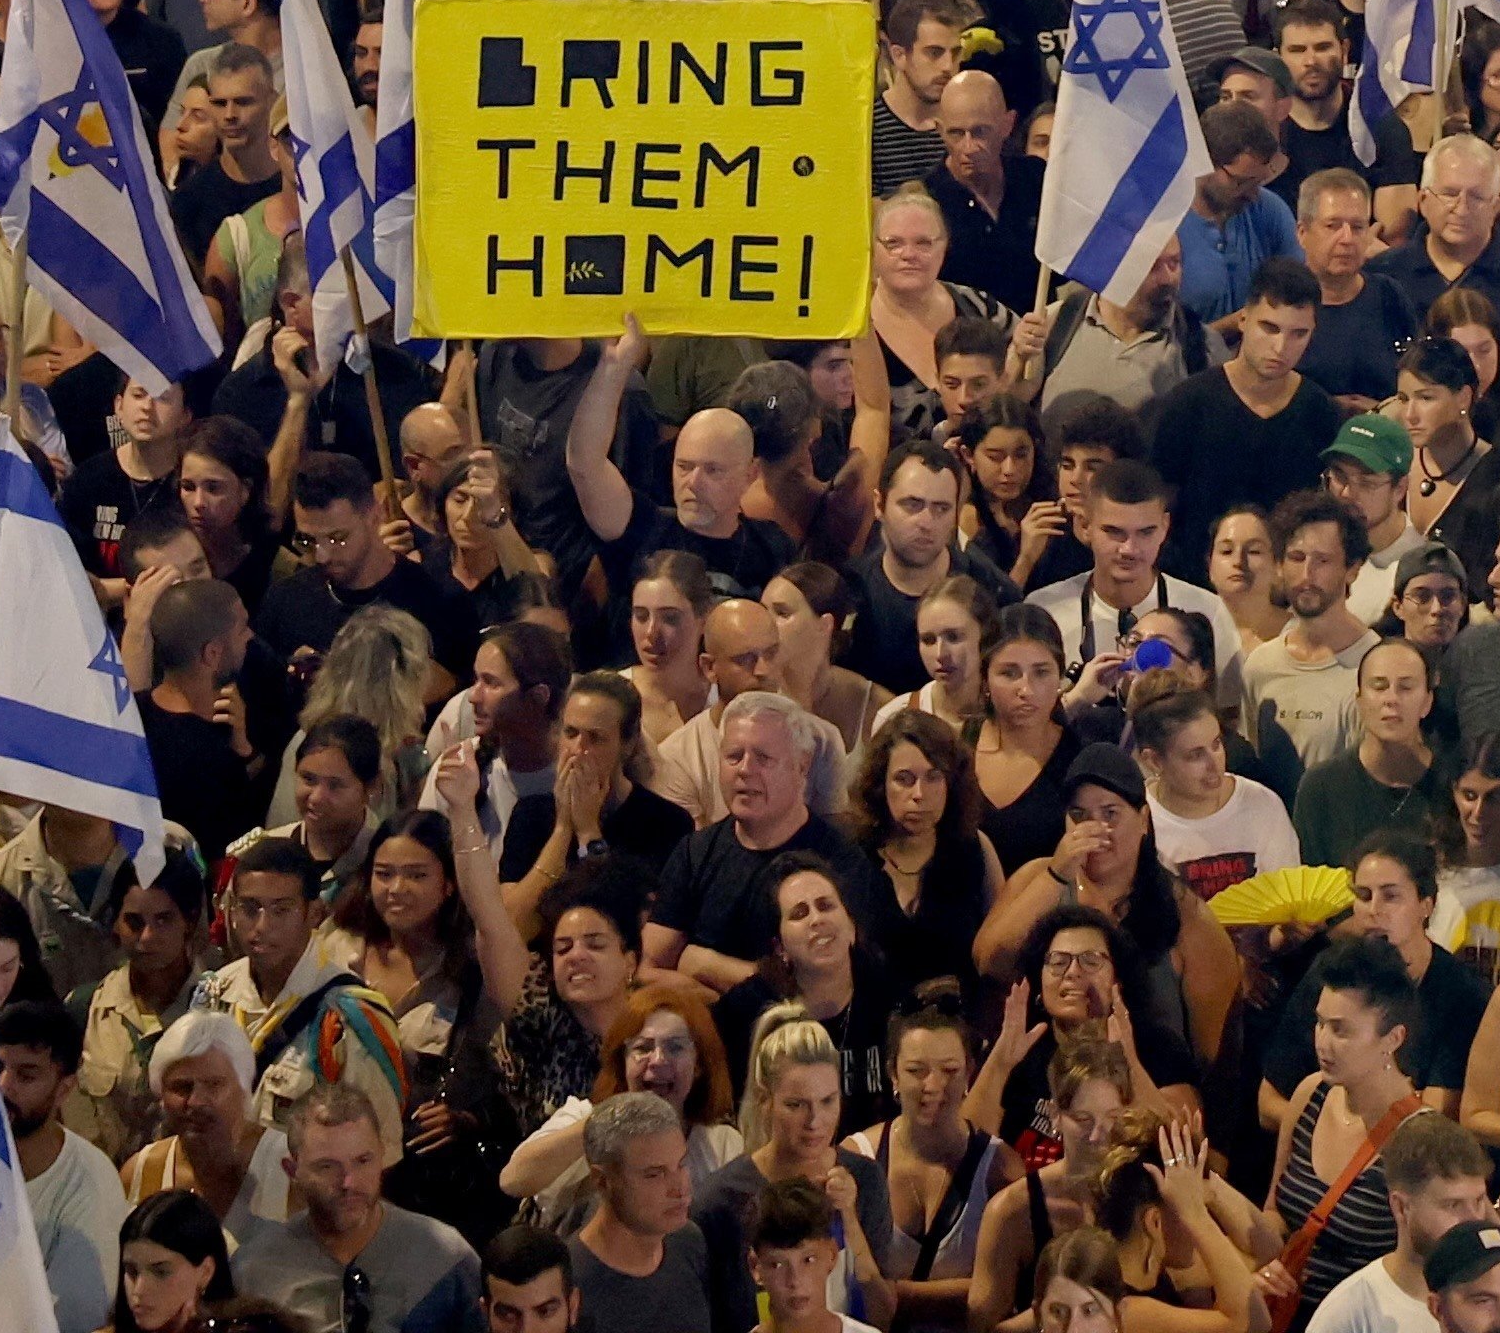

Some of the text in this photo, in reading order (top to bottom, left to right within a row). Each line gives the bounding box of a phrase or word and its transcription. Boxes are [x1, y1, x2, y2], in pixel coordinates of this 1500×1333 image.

[477, 35, 805, 110] BRING
[477, 137, 762, 210] THEM
[487, 232, 814, 318] HOME!
